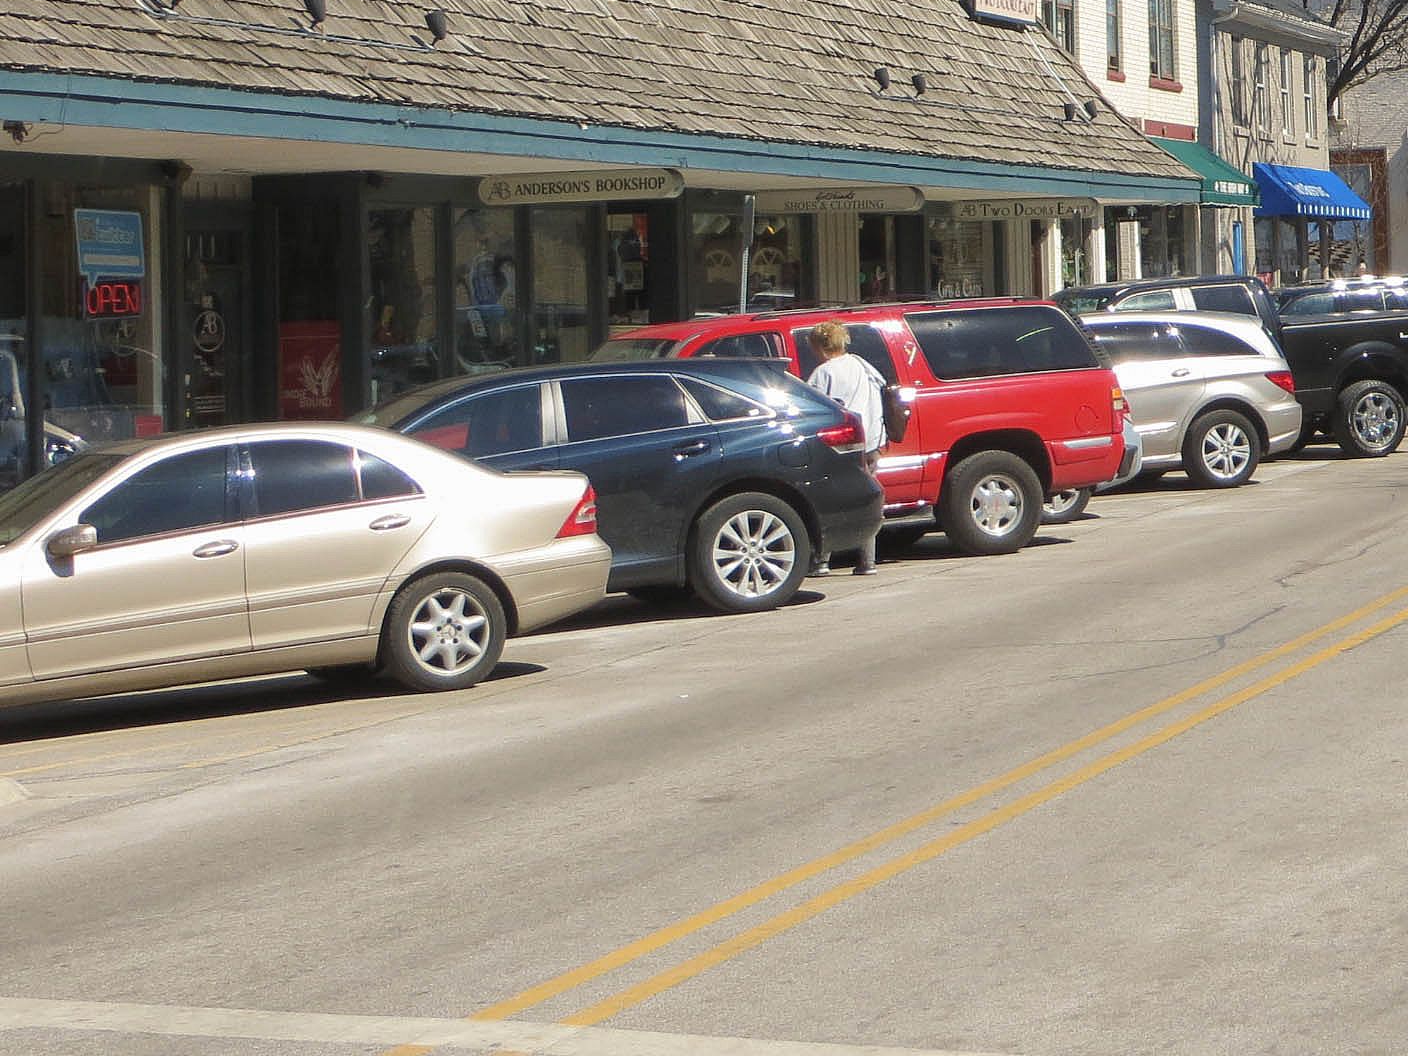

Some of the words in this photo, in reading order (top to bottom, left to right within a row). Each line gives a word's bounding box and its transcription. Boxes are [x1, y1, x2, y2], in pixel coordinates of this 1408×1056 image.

[514, 181, 590, 196] ANDERSON'S
[596, 176, 666, 193] BOOKSHOP
[784, 200, 816, 210] SHOES
[817, 201, 826, 210] &
[830, 200, 885, 210] CLOTHING
[87, 284, 141, 315] OPEN
